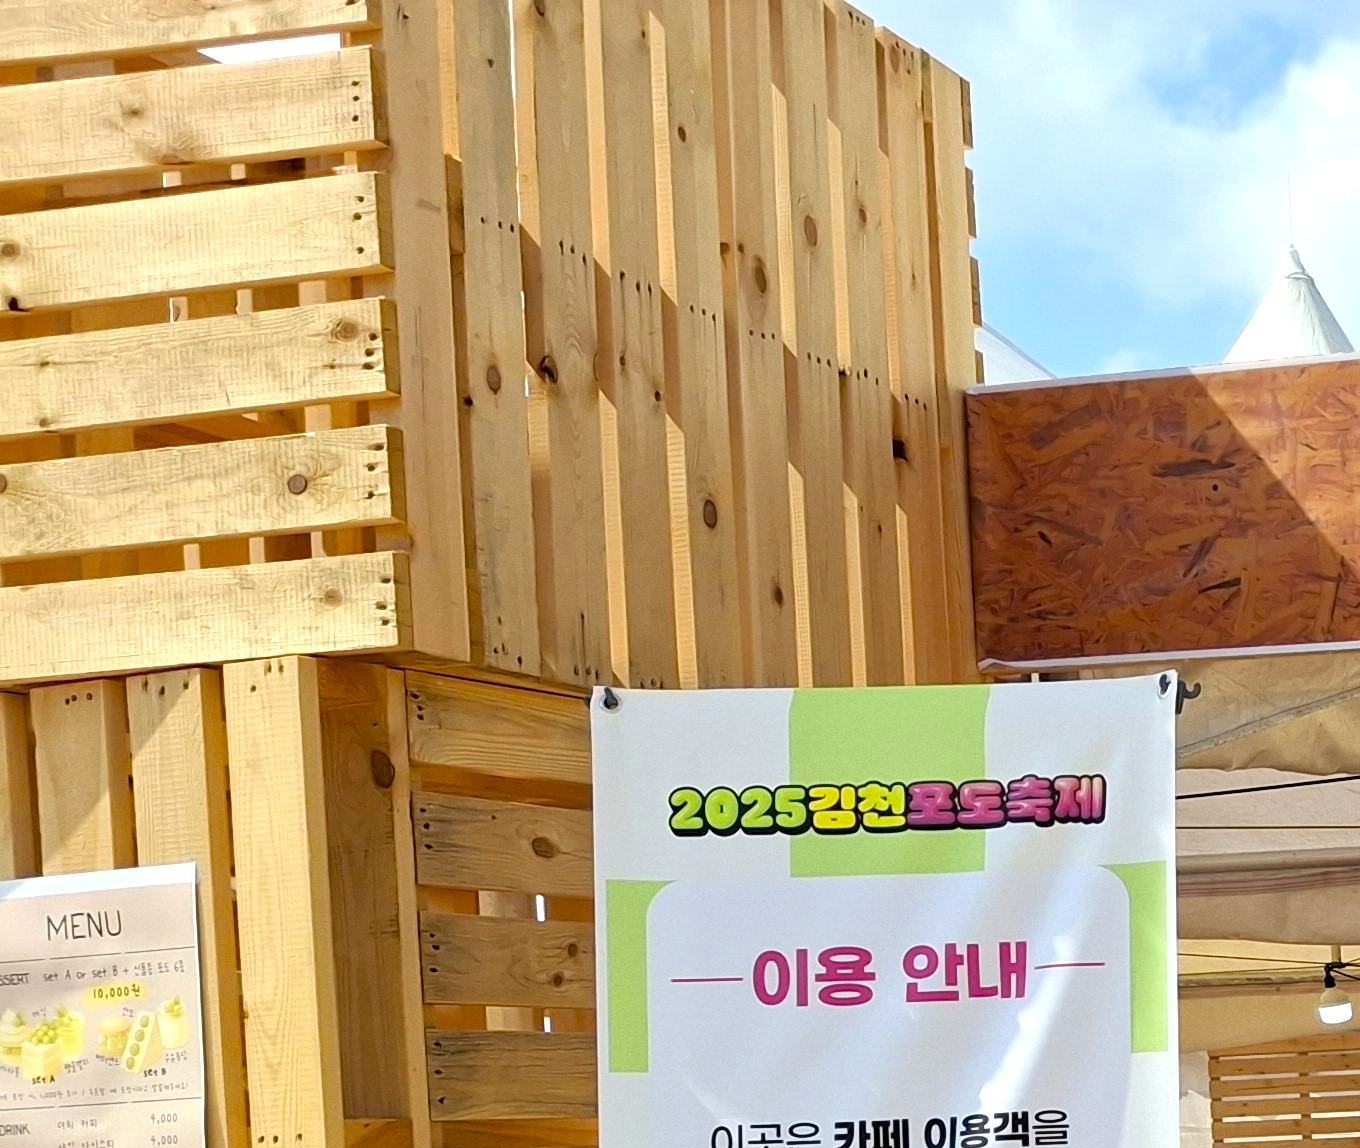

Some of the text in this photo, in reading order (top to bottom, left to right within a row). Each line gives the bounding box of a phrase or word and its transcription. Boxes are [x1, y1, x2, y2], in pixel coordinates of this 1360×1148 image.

[668, 773, 1106, 837] 2025김천포도축제
[46, 910, 123, 941] MENU
[65, 970, 72, 980] A
[76, 972, 87, 980] or
[92, 969, 107, 979] set
[752, 941, 1028, 1008] 이용 안내
[93, 983, 140, 1000] 10,000원
[0, 1124, 31, 1136] DRINK
[150, 1113, 178, 1125] 4,000
[150, 1134, 179, 1146] 4,000
